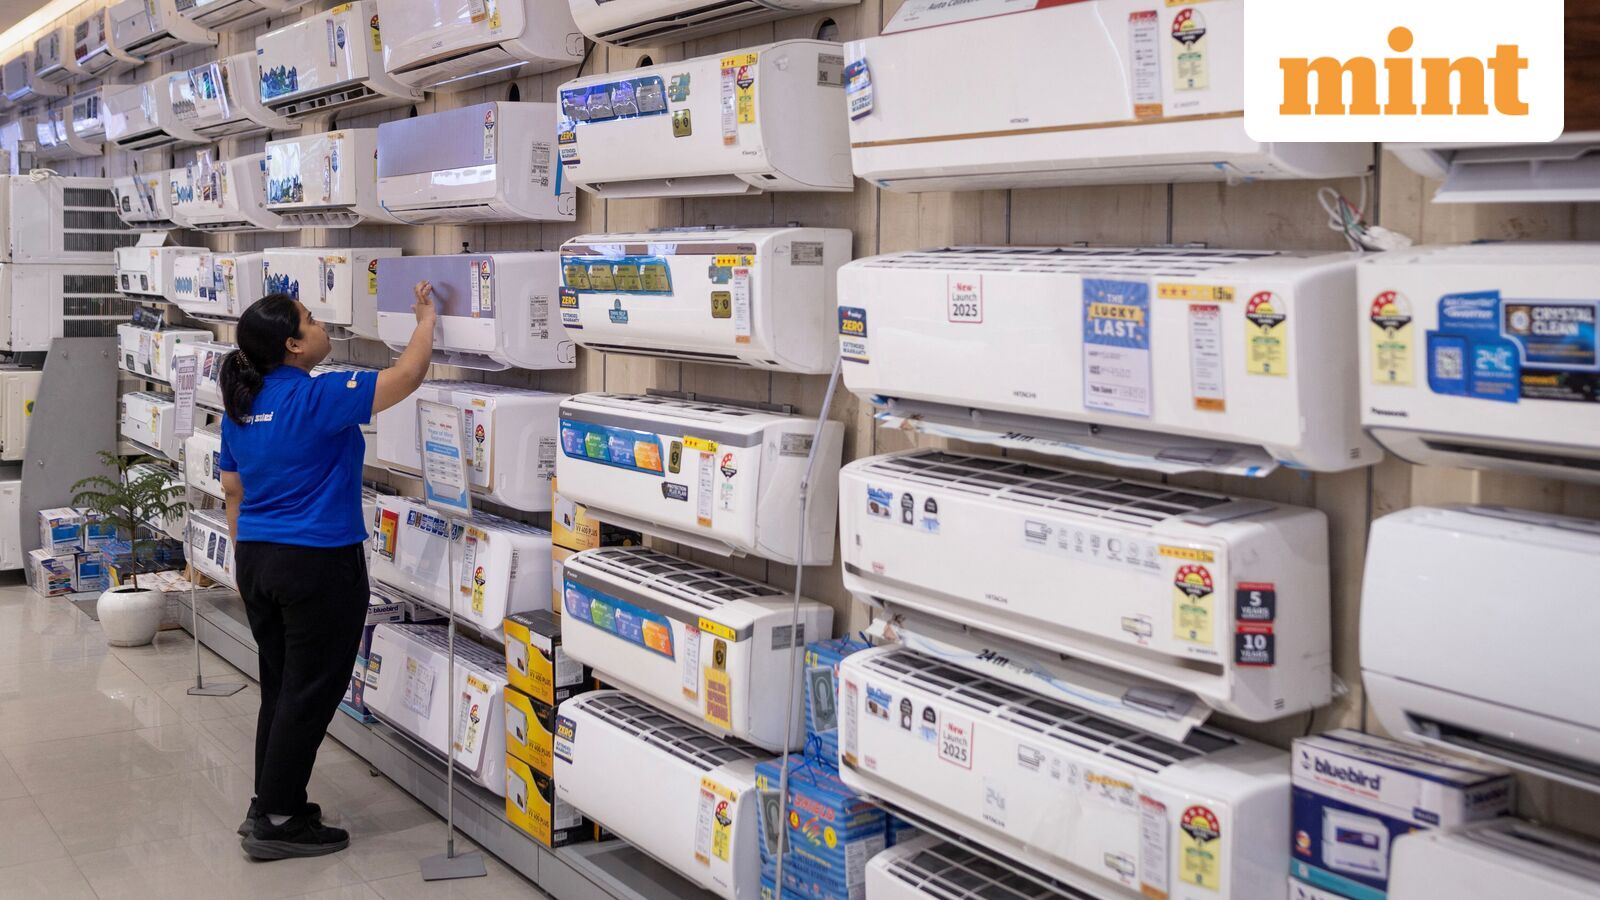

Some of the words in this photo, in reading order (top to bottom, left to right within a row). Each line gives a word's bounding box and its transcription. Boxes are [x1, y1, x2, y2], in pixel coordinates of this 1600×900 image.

[957, 283, 973, 292] New
[562, 296, 576, 305] ZERO
[952, 292, 977, 302] Launch
[953, 303, 978, 317] 2025
[1094, 307, 1137, 319] LUCKY
[842, 319, 864, 333] ZERO
[1093, 318, 1137, 340] LAST
[1531, 321, 1580, 336] CLEAN
[1249, 591, 1262, 606] 5
[373, 605, 399, 614] bluebird
[1241, 606, 1269, 614] YEARS
[1243, 634, 1267, 650] 10
[1241, 649, 1268, 658] YEARS
[558, 725, 573, 738] ZERO
[948, 722, 964, 735] New
[943, 732, 968, 747] Launch
[943, 742, 968, 762] 2025
[1315, 757, 1382, 791] bluebird
